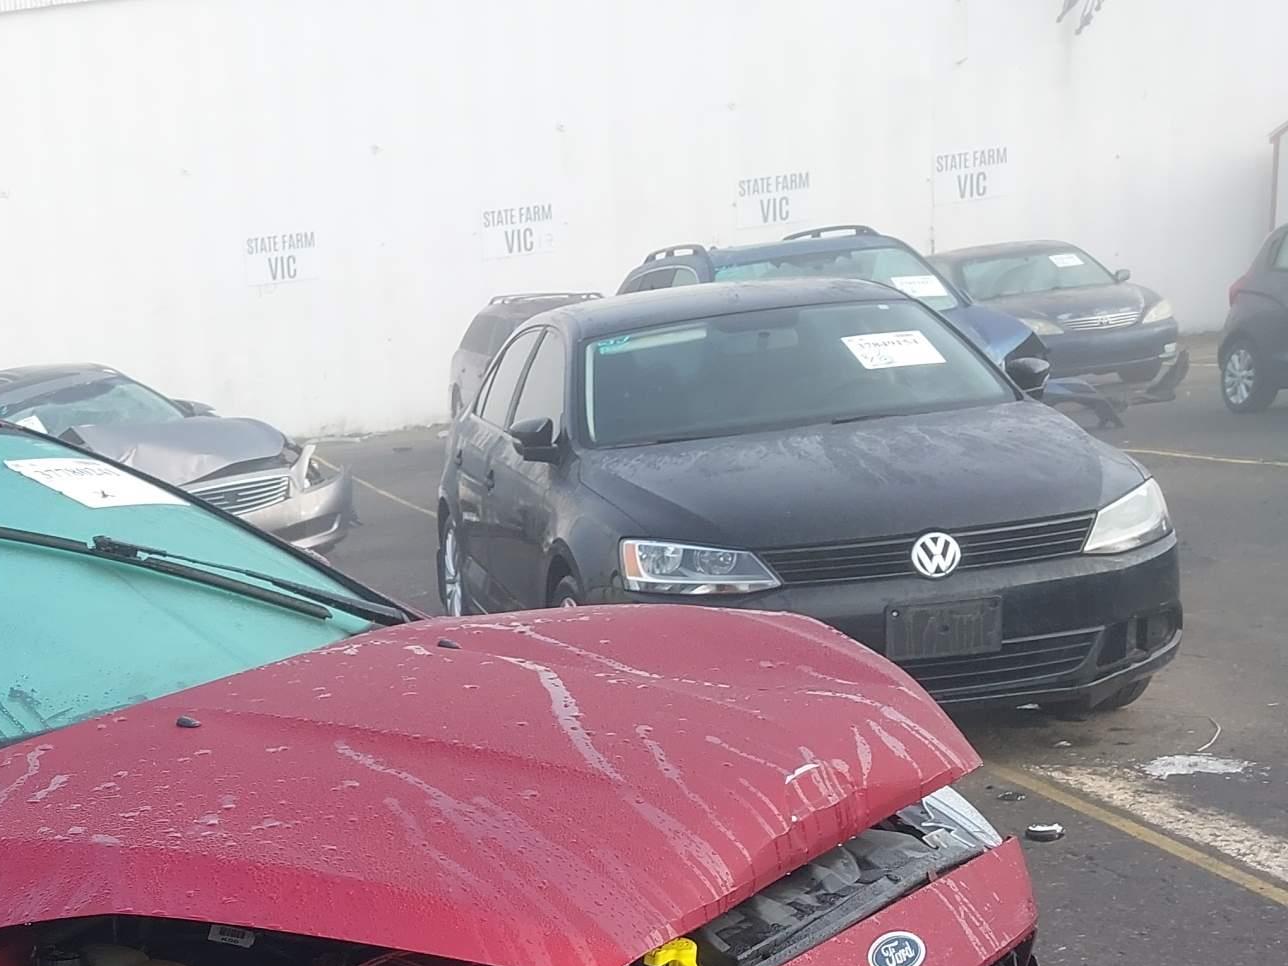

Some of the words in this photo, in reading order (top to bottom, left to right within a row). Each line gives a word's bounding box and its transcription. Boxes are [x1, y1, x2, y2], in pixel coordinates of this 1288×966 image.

[936, 152, 970, 173] STATE
[972, 146, 1008, 168] FARM
[738, 176, 772, 197] STATE
[775, 171, 809, 193] FARM
[957, 171, 987, 200] VIC
[483, 207, 516, 228] STATE
[518, 203, 552, 224] FARM
[759, 196, 790, 223] VIC
[247, 235, 279, 255] STATE
[281, 231, 316, 251] FARM
[504, 227, 534, 254] VIC
[267, 254, 297, 281] VIC
